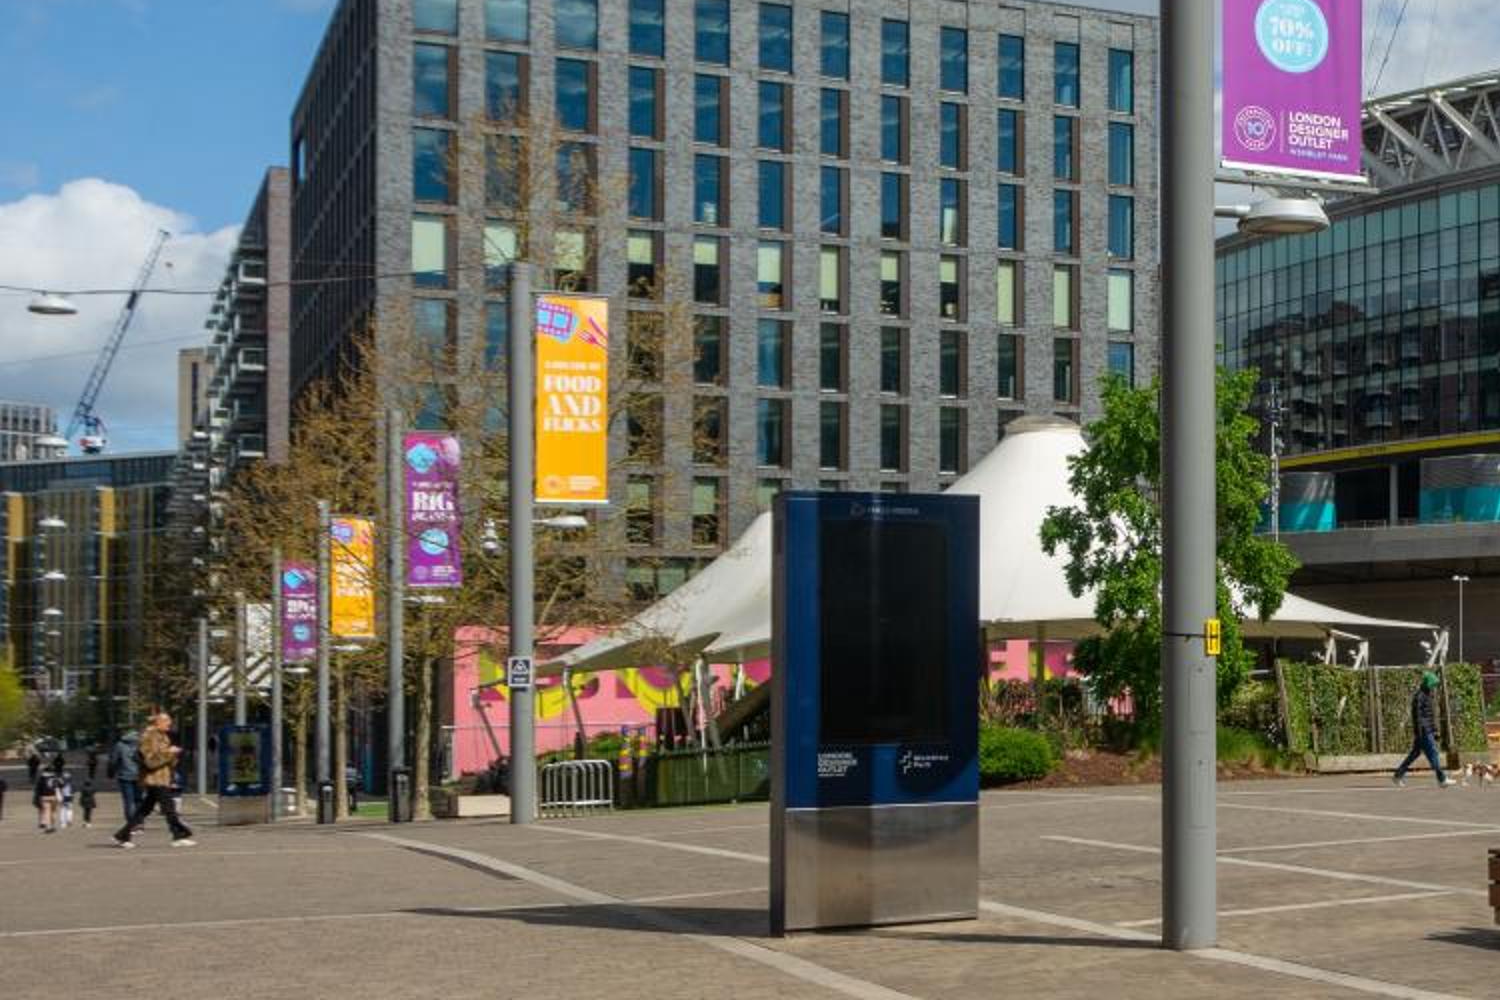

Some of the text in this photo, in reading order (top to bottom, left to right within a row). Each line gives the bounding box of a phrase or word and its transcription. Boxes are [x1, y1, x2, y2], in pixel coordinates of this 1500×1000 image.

[1269, 16, 1315, 39] 70%
[1288, 111, 1341, 128] LONDON
[1288, 122, 1349, 142] DESIGNER
[1288, 134, 1333, 149] OUTLET
[543, 375, 602, 393] FOOD
[546, 393, 602, 416] AND
